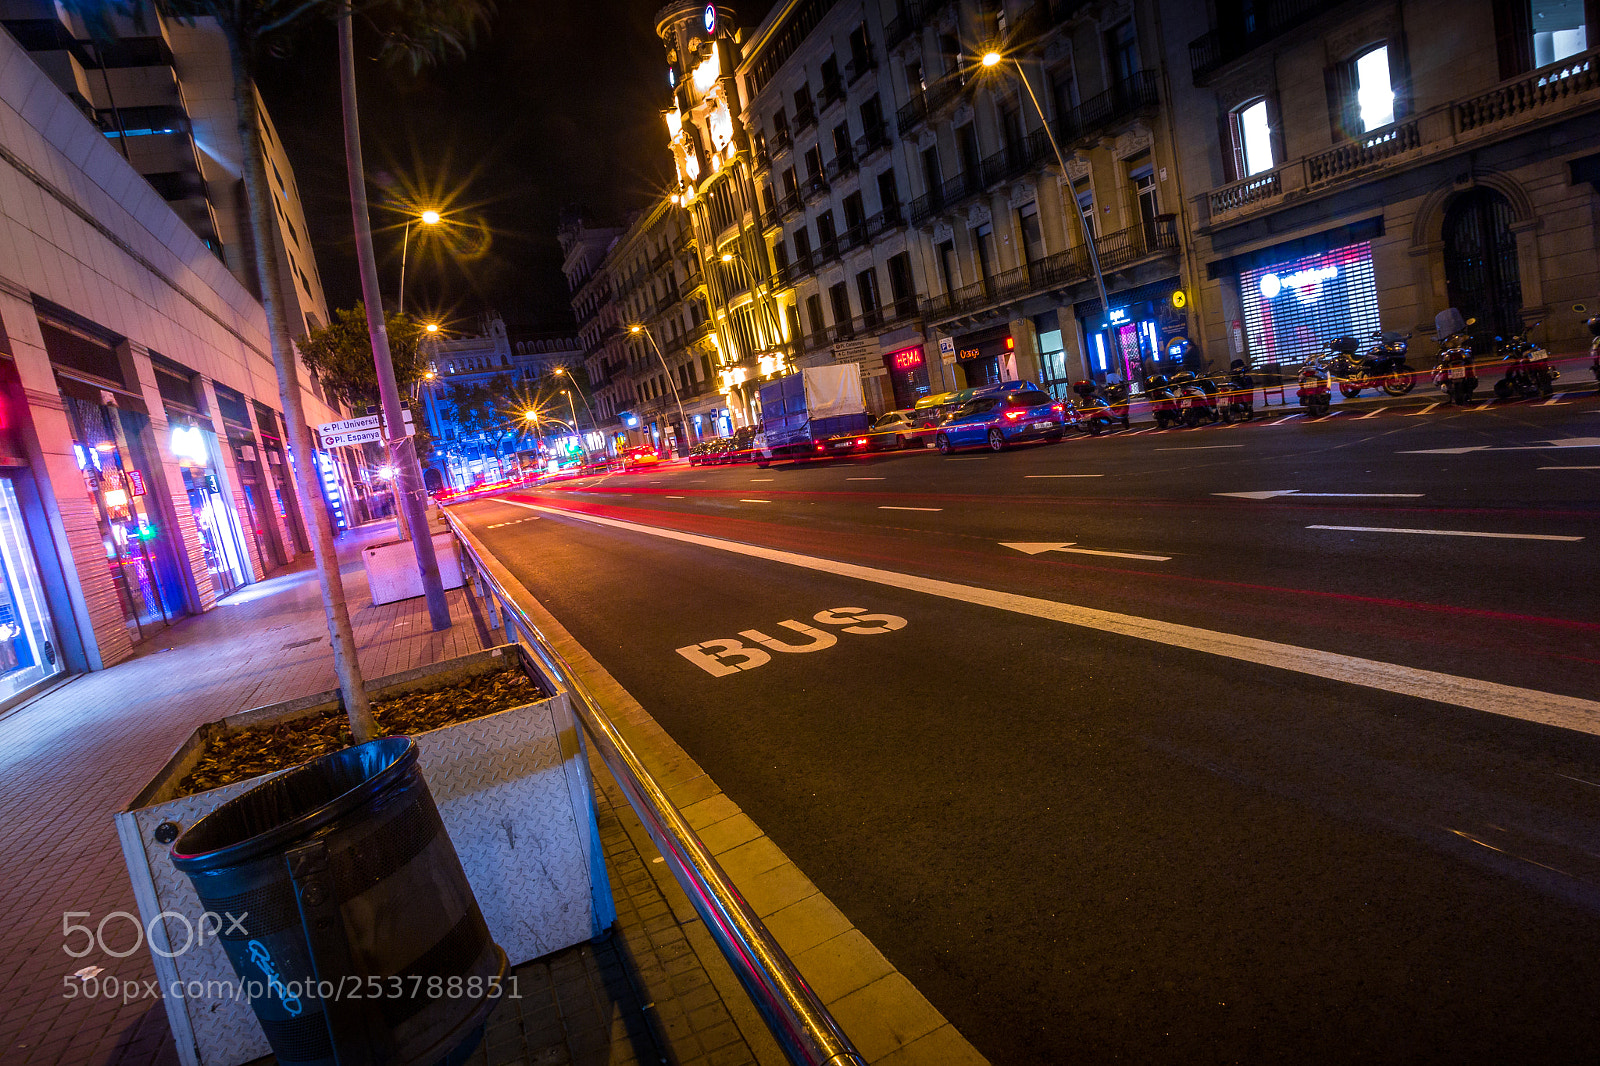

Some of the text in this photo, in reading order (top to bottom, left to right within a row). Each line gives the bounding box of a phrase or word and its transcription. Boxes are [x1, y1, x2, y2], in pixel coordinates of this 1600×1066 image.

[896, 350, 921, 369] HEMA
[331, 417, 385, 431] Pl. Universit
[347, 431, 380, 442] Espanya
[130, 471, 145, 496] CAMPER
[675, 606, 908, 678] BUS
